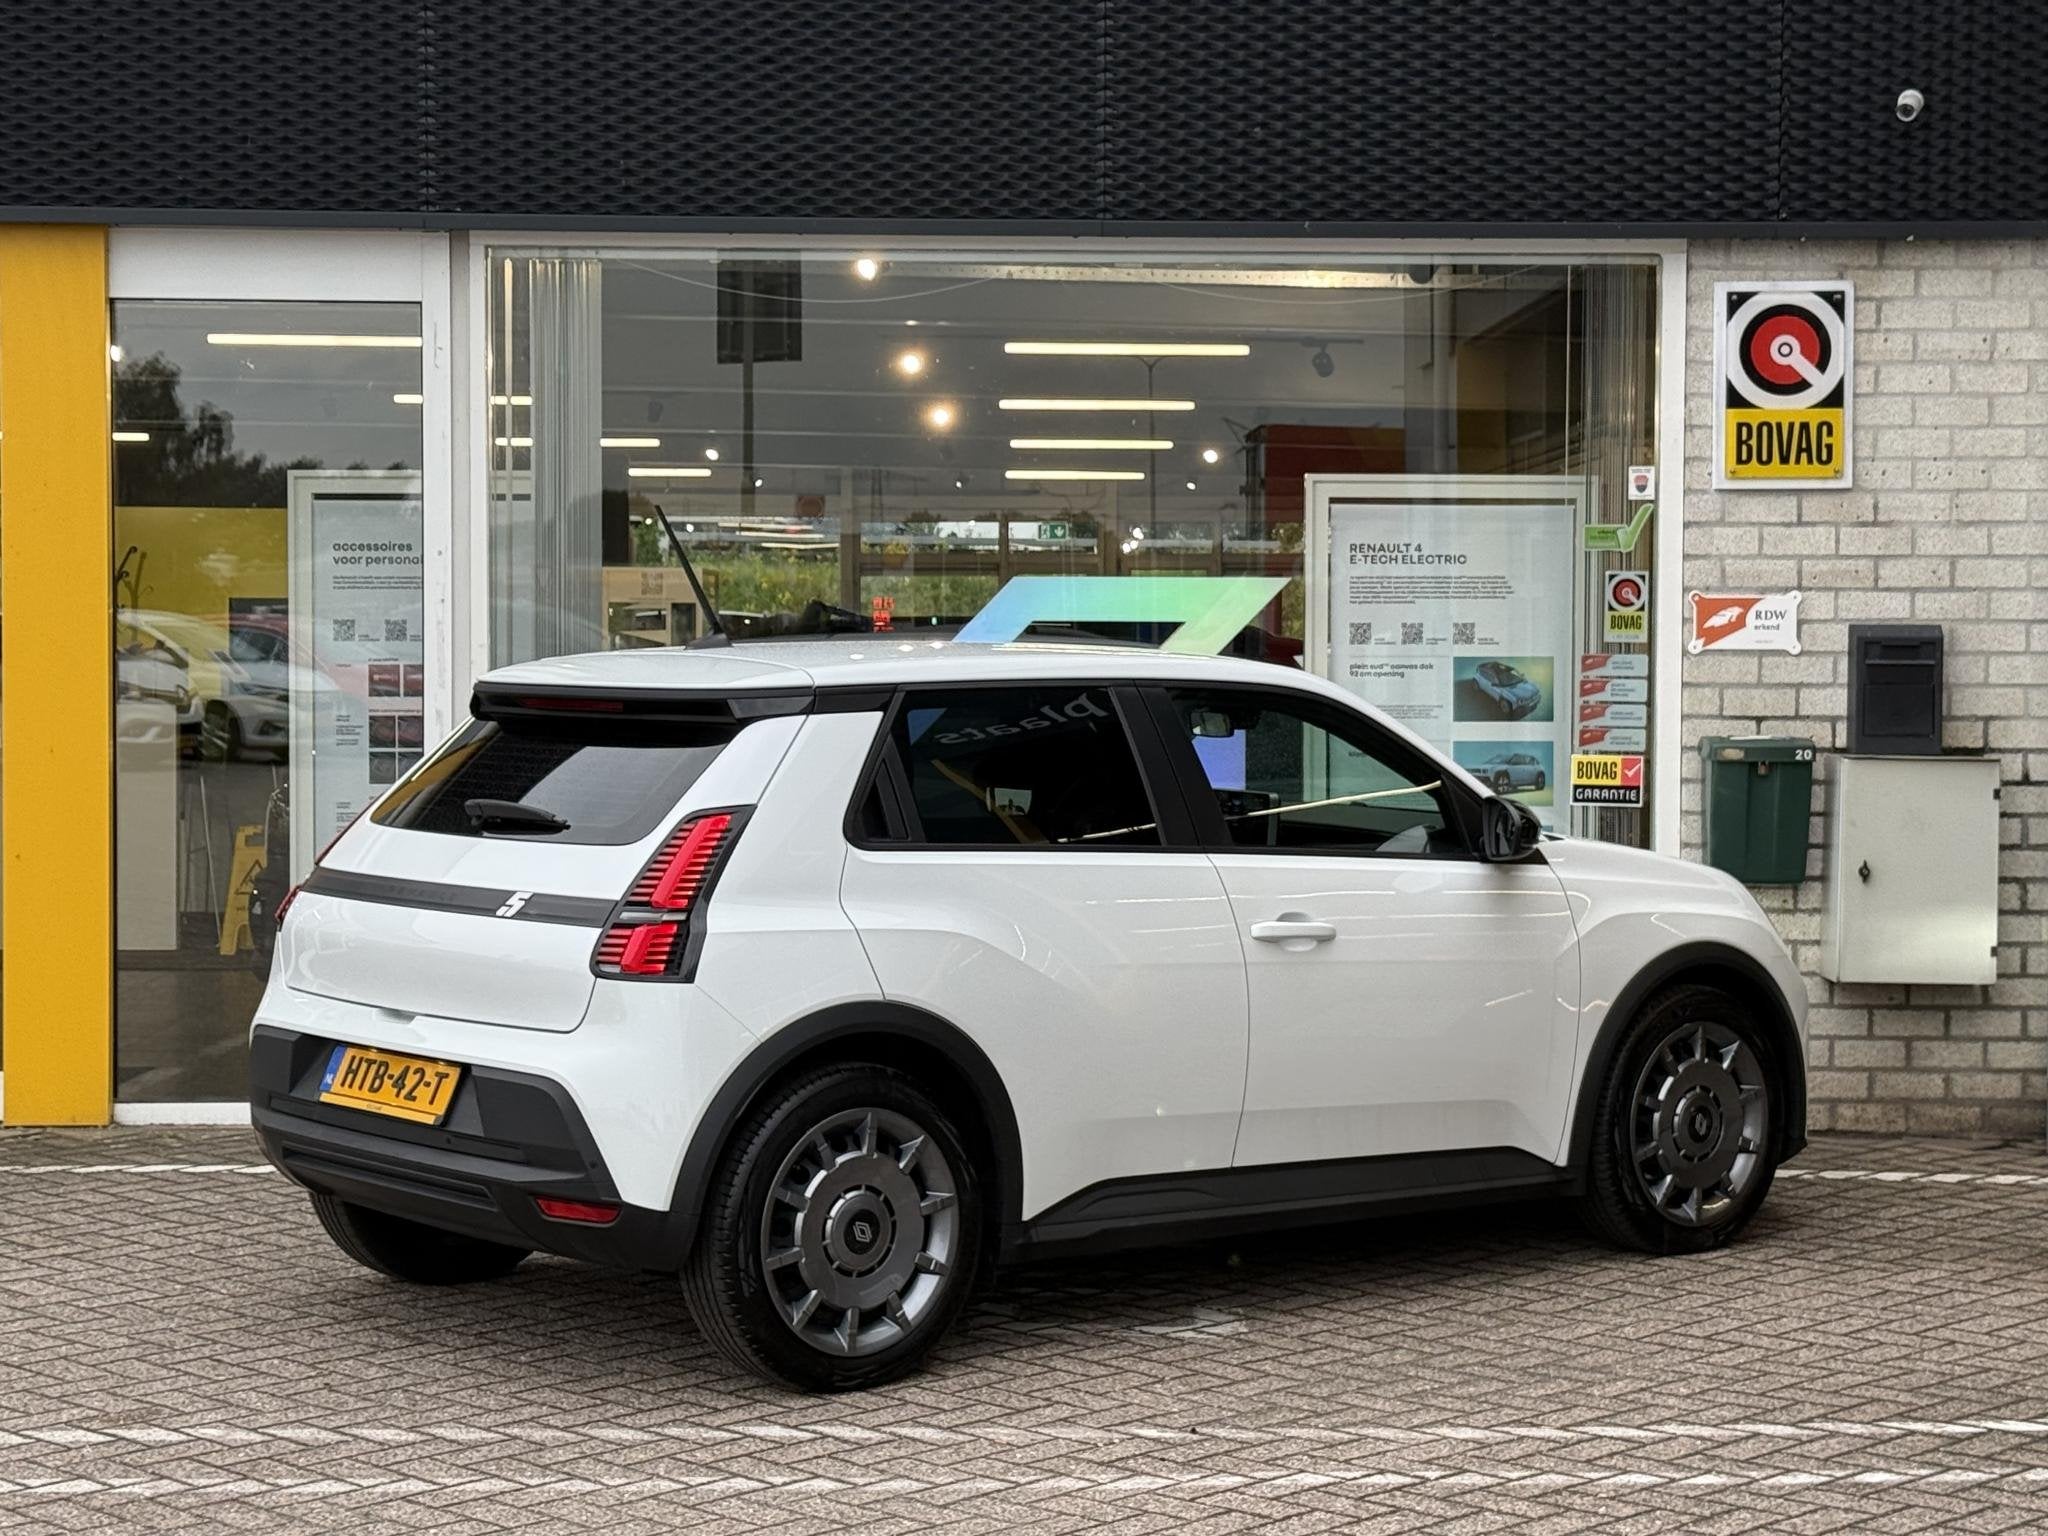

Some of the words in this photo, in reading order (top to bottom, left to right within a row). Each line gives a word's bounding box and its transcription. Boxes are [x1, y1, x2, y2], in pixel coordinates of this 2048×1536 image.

[1735, 420, 1834, 466] BOVAG
[332, 541, 413, 552] accessoires
[1349, 543, 1412, 554] RENAULT
[1414, 543, 1423, 553] 4
[333, 556, 362, 565] voor
[1349, 554, 1398, 565] E-TECH
[1401, 554, 1468, 565] ELECTRIC
[1755, 609, 1787, 621] RDW
[1610, 614, 1642, 631] BOVAG
[1754, 623, 1780, 631] erkend
[1372, 670, 1405, 679] opening
[1794, 748, 1812, 761] 20
[1576, 760, 1618, 780] BOVAG
[1575, 788, 1638, 802] GARANTIE
[340, 1054, 450, 1106] HTB-42-T
